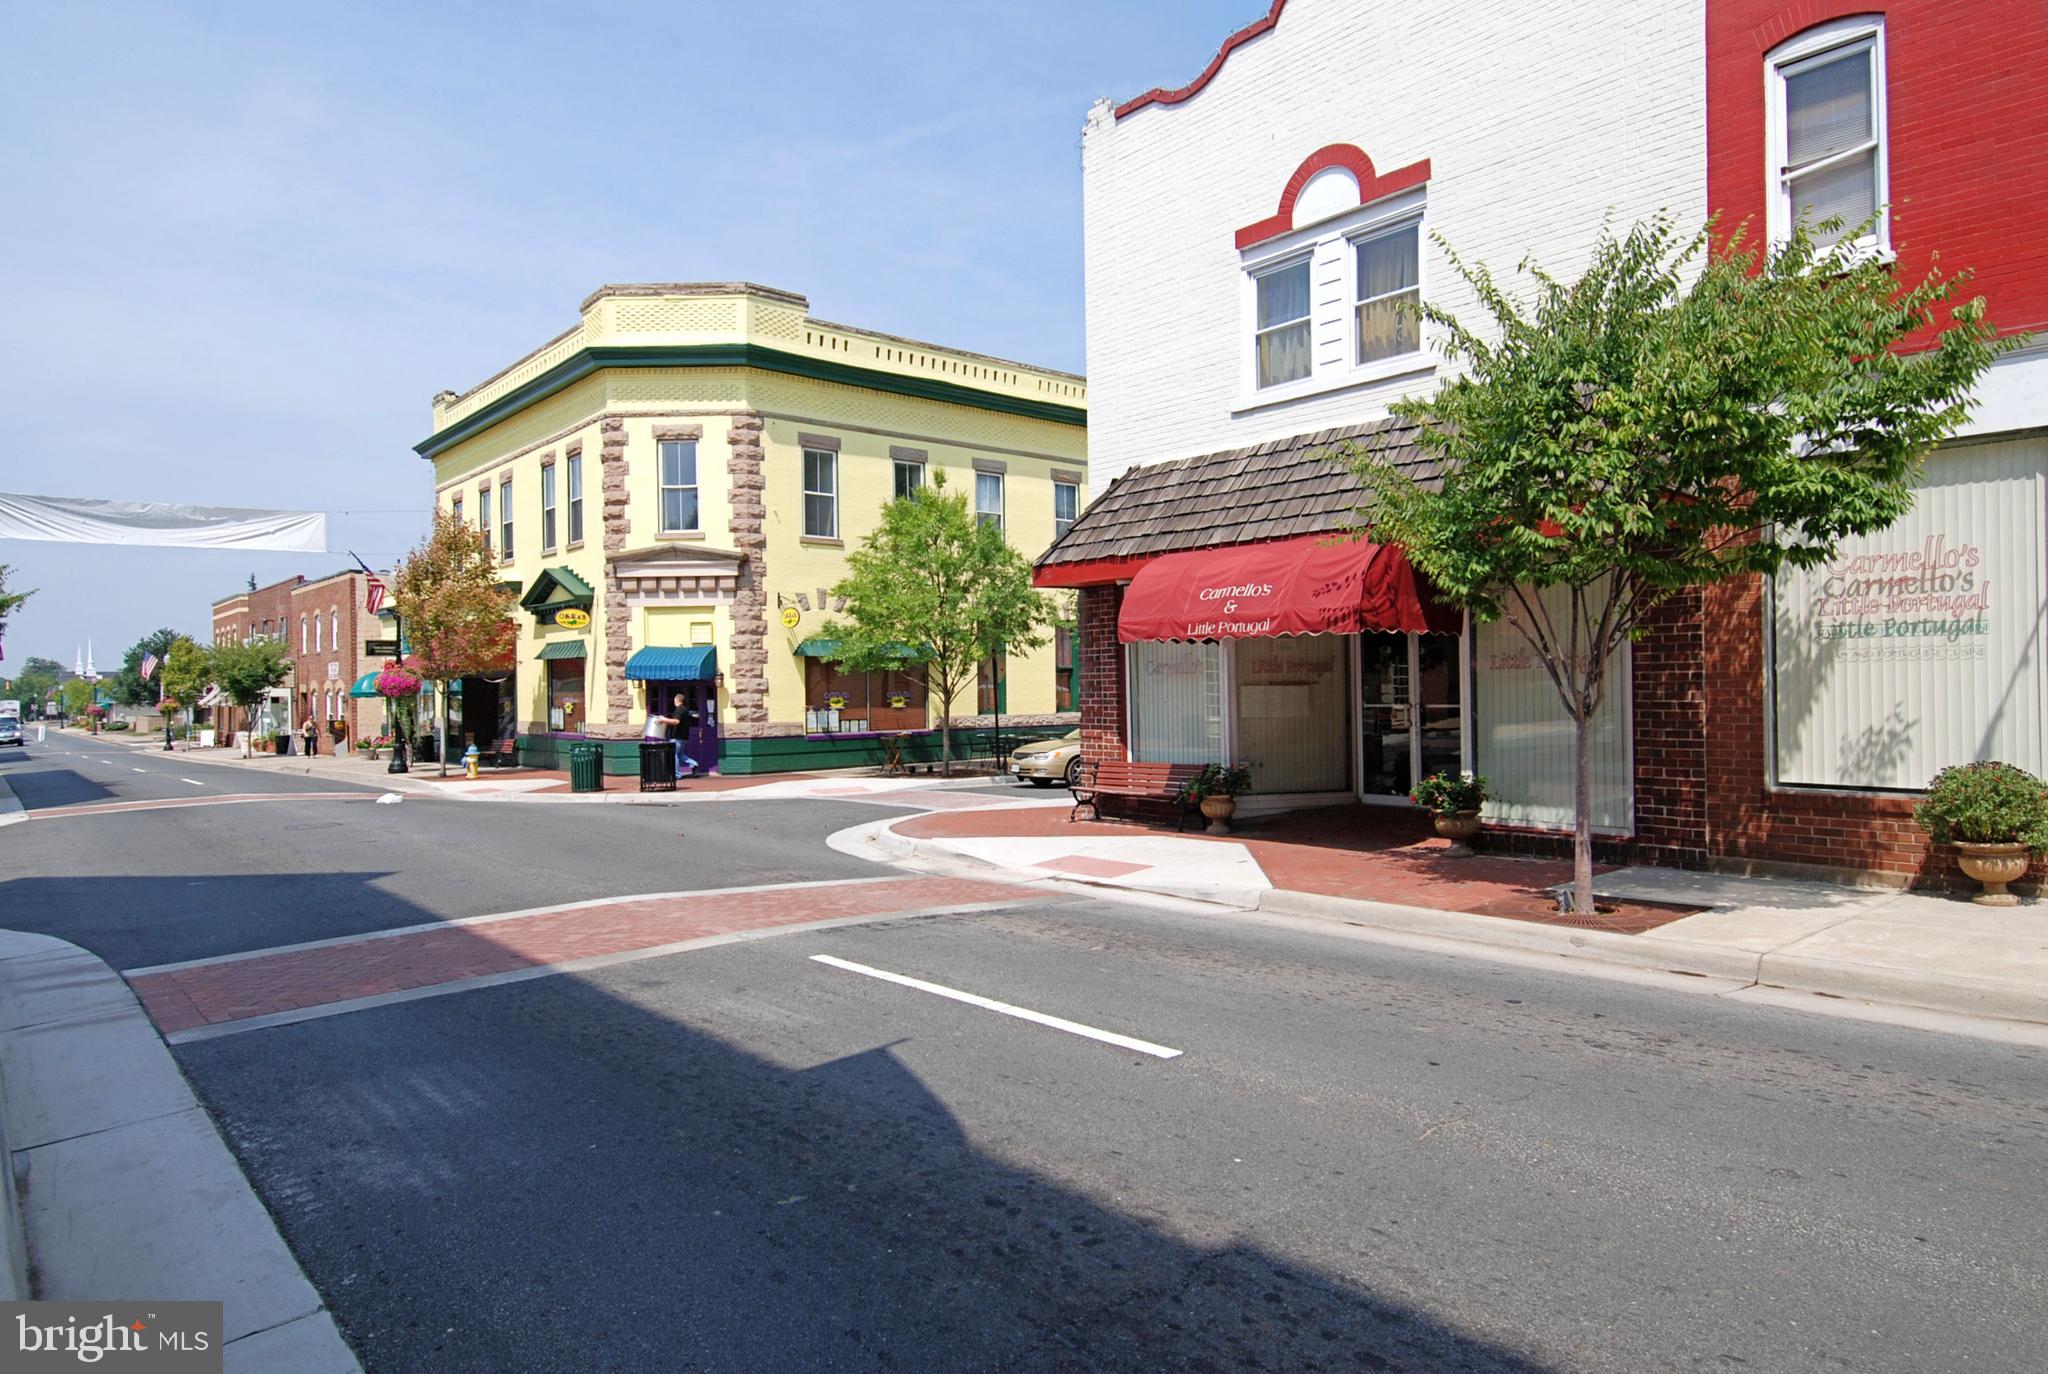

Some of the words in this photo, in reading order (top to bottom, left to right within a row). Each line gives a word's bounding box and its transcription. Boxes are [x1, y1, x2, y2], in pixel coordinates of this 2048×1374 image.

[1826, 534, 1980, 576] Carmello's
[1200, 584, 1272, 601] Carmello's
[1818, 587, 1880, 617] Little
[1887, 581, 1990, 619] Portugal
[1224, 600, 1237, 614] &
[1187, 622, 1216, 635] Little
[1218, 618, 1270, 635] Portugal
